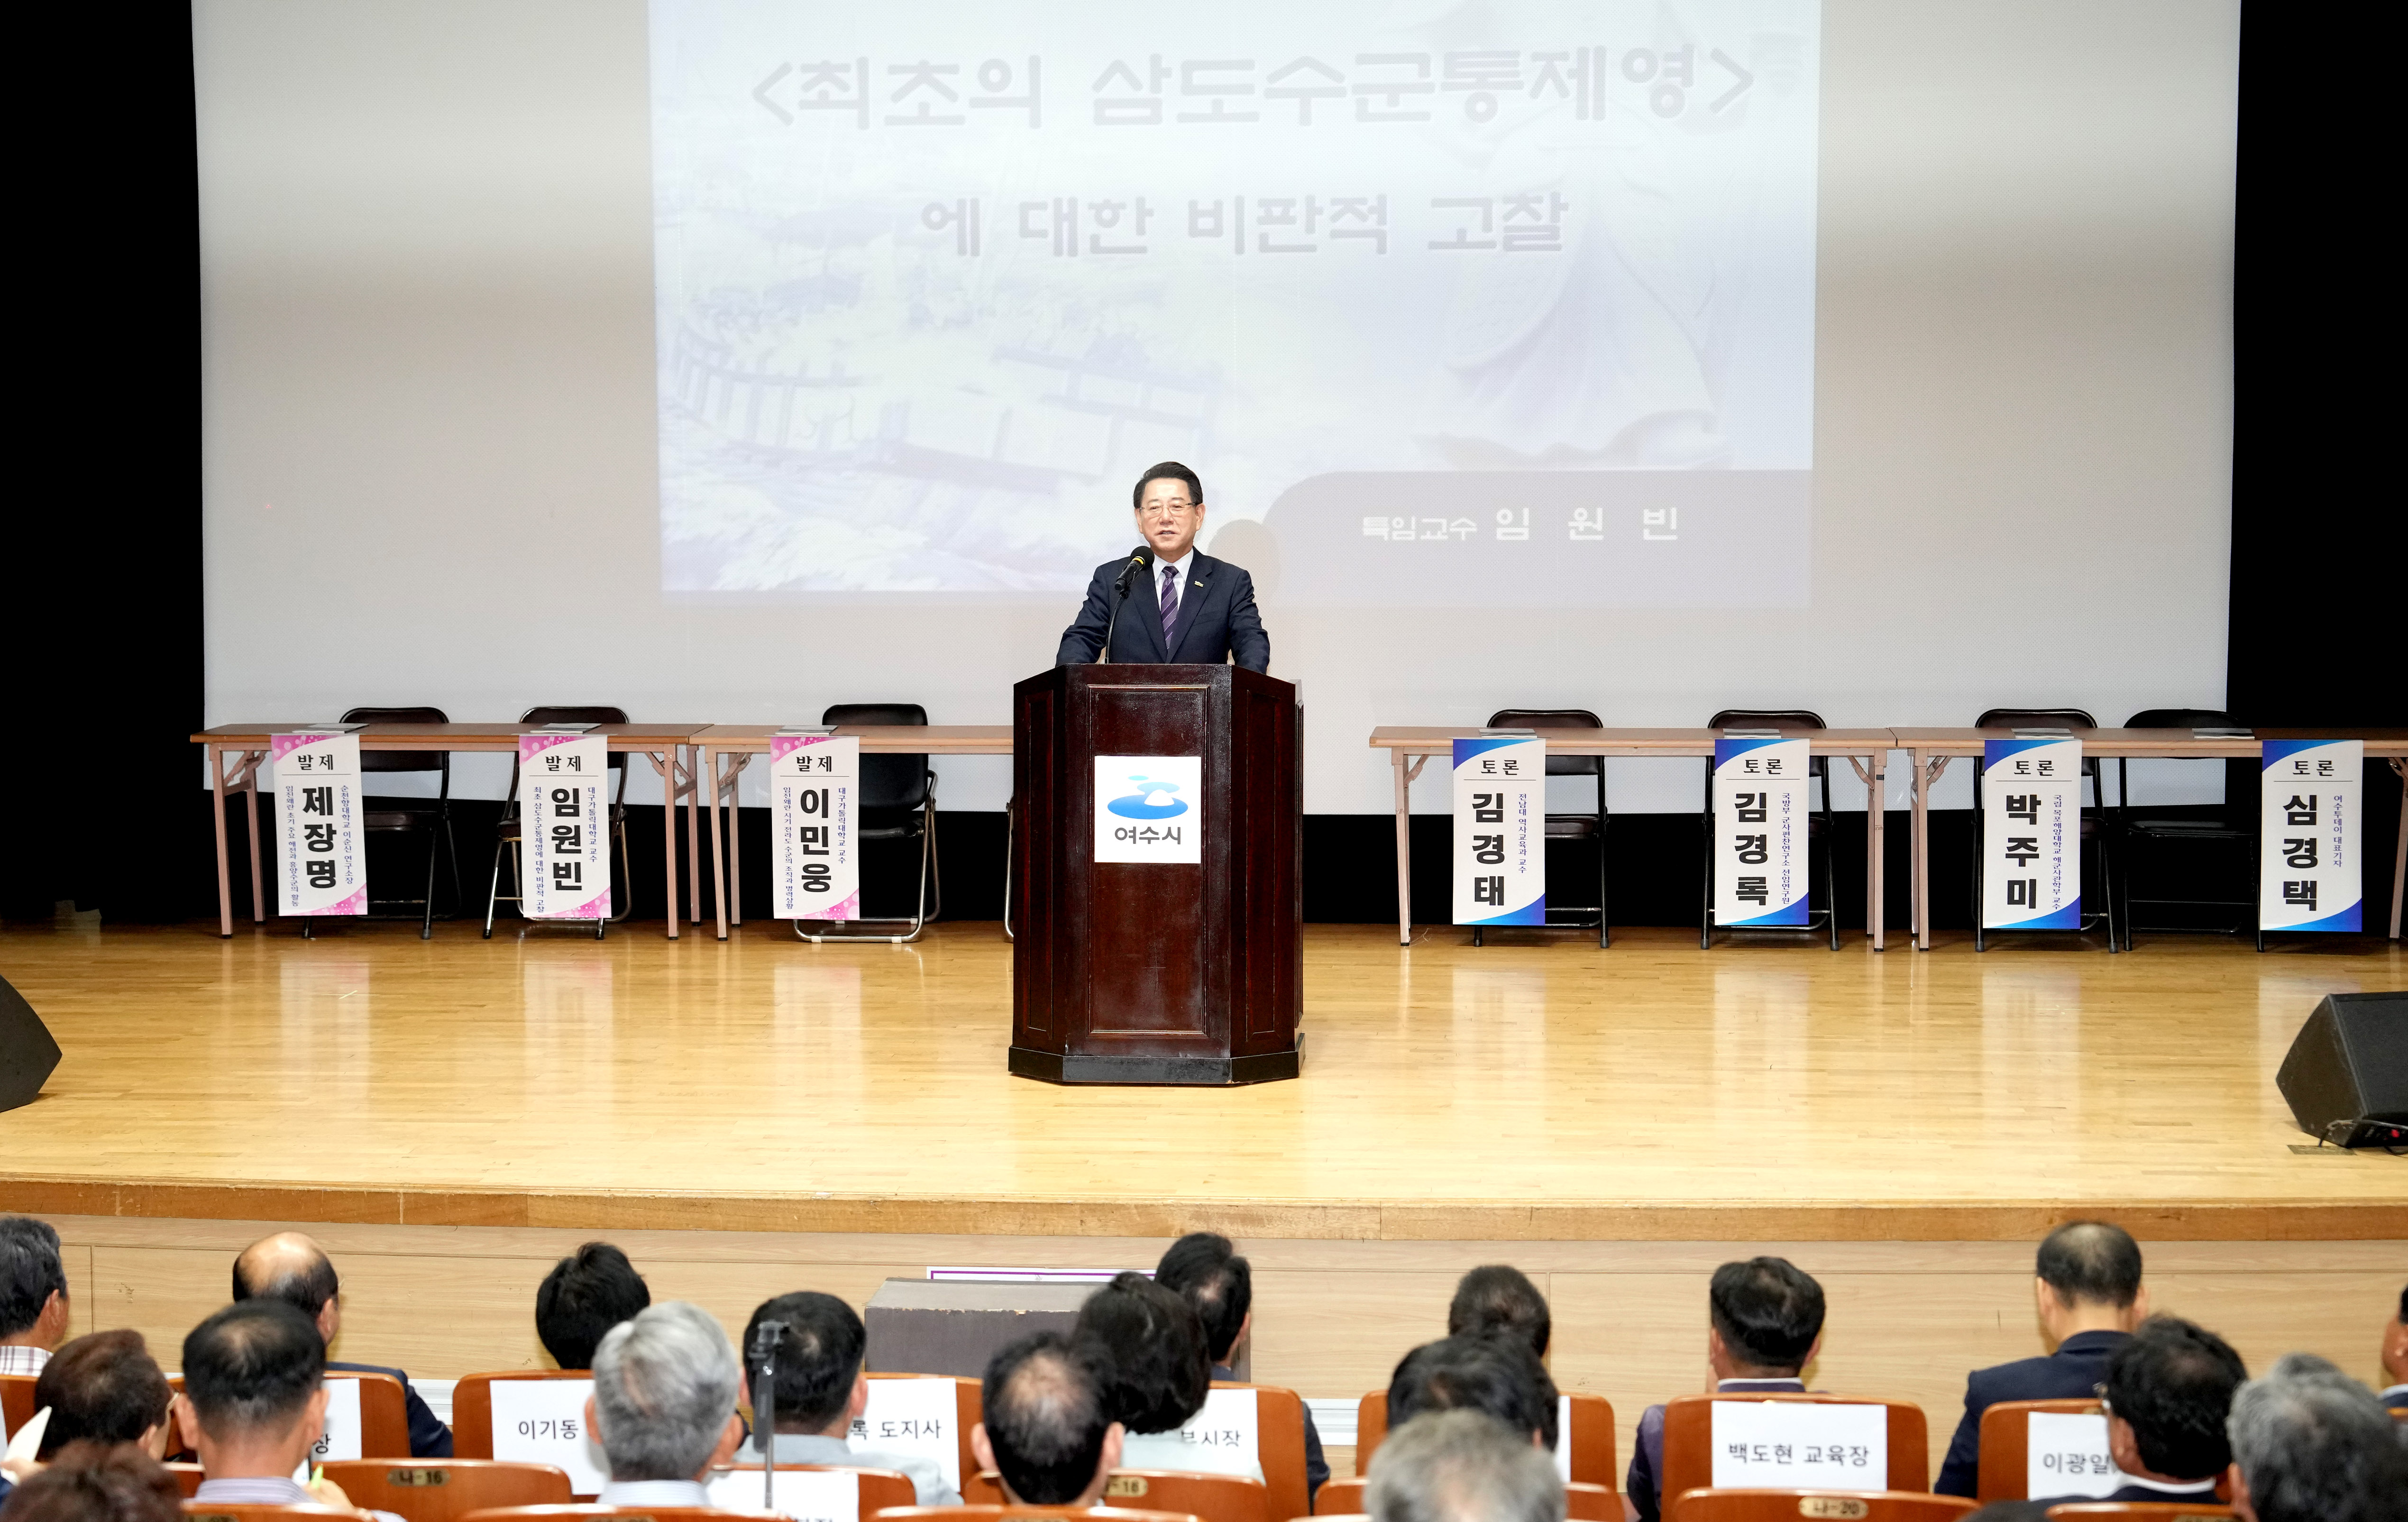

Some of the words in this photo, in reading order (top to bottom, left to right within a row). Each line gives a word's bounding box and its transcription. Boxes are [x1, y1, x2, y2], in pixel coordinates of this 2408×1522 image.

[751, 54, 1044, 130] <최초의
[1090, 43, 1755, 126] 삼도수군통제영>
[920, 198, 982, 257] 에
[1018, 197, 1154, 257] 대한
[1186, 194, 1390, 256] 비판적
[1427, 192, 1569, 252] 고찰
[1363, 516, 1477, 541] 특임교수
[340, 785, 350, 828] 순천향대학교
[534, 787, 541, 799] 최초
[1782, 793, 1791, 814] 국방부
[2054, 795, 2062, 807] 국립
[534, 803, 542, 857] 삼도수군통제영에
[588, 787, 597, 844] 대구가톨릭대학교
[785, 813, 791, 825] 시기
[838, 788, 846, 846] 대구가톨릭대학교
[2053, 810, 2062, 853] 목포해양대학교
[2334, 795, 2343, 834] 여수투데이
[302, 787, 337, 889] 제장명
[343, 831, 351, 853] 이순신
[551, 788, 582, 890] 임원빈
[800, 789, 831, 892] 이민웅
[1115, 826, 1181, 844] 여수시
[1472, 793, 1505, 906] 김경태
[1519, 819, 1527, 856] 역사교육과
[1735, 793, 1768, 906] 김경록
[1782, 817, 1790, 865] 군사편찬연구소
[2005, 795, 2041, 909] 박주미
[2333, 837, 2342, 867] 대표기자
[344, 855, 353, 884] 연구소장
[536, 861, 544, 873] 대한
[590, 849, 597, 862] 교수
[838, 850, 846, 864] 교수
[1519, 859, 1526, 873] 교수
[2282, 795, 2318, 911] 심경택
[1782, 869, 1790, 904] 선임연구원
[2052, 857, 2061, 895] 해군사관학부
[537, 900, 544, 912] 고찰
[2052, 898, 2061, 909] 교수
[518, 1420, 578, 1440] 이기동
[879, 1419, 941, 1439] 도지사
[1729, 1444, 1793, 1465] 백도현
[1804, 1445, 1870, 1468] 교육장
